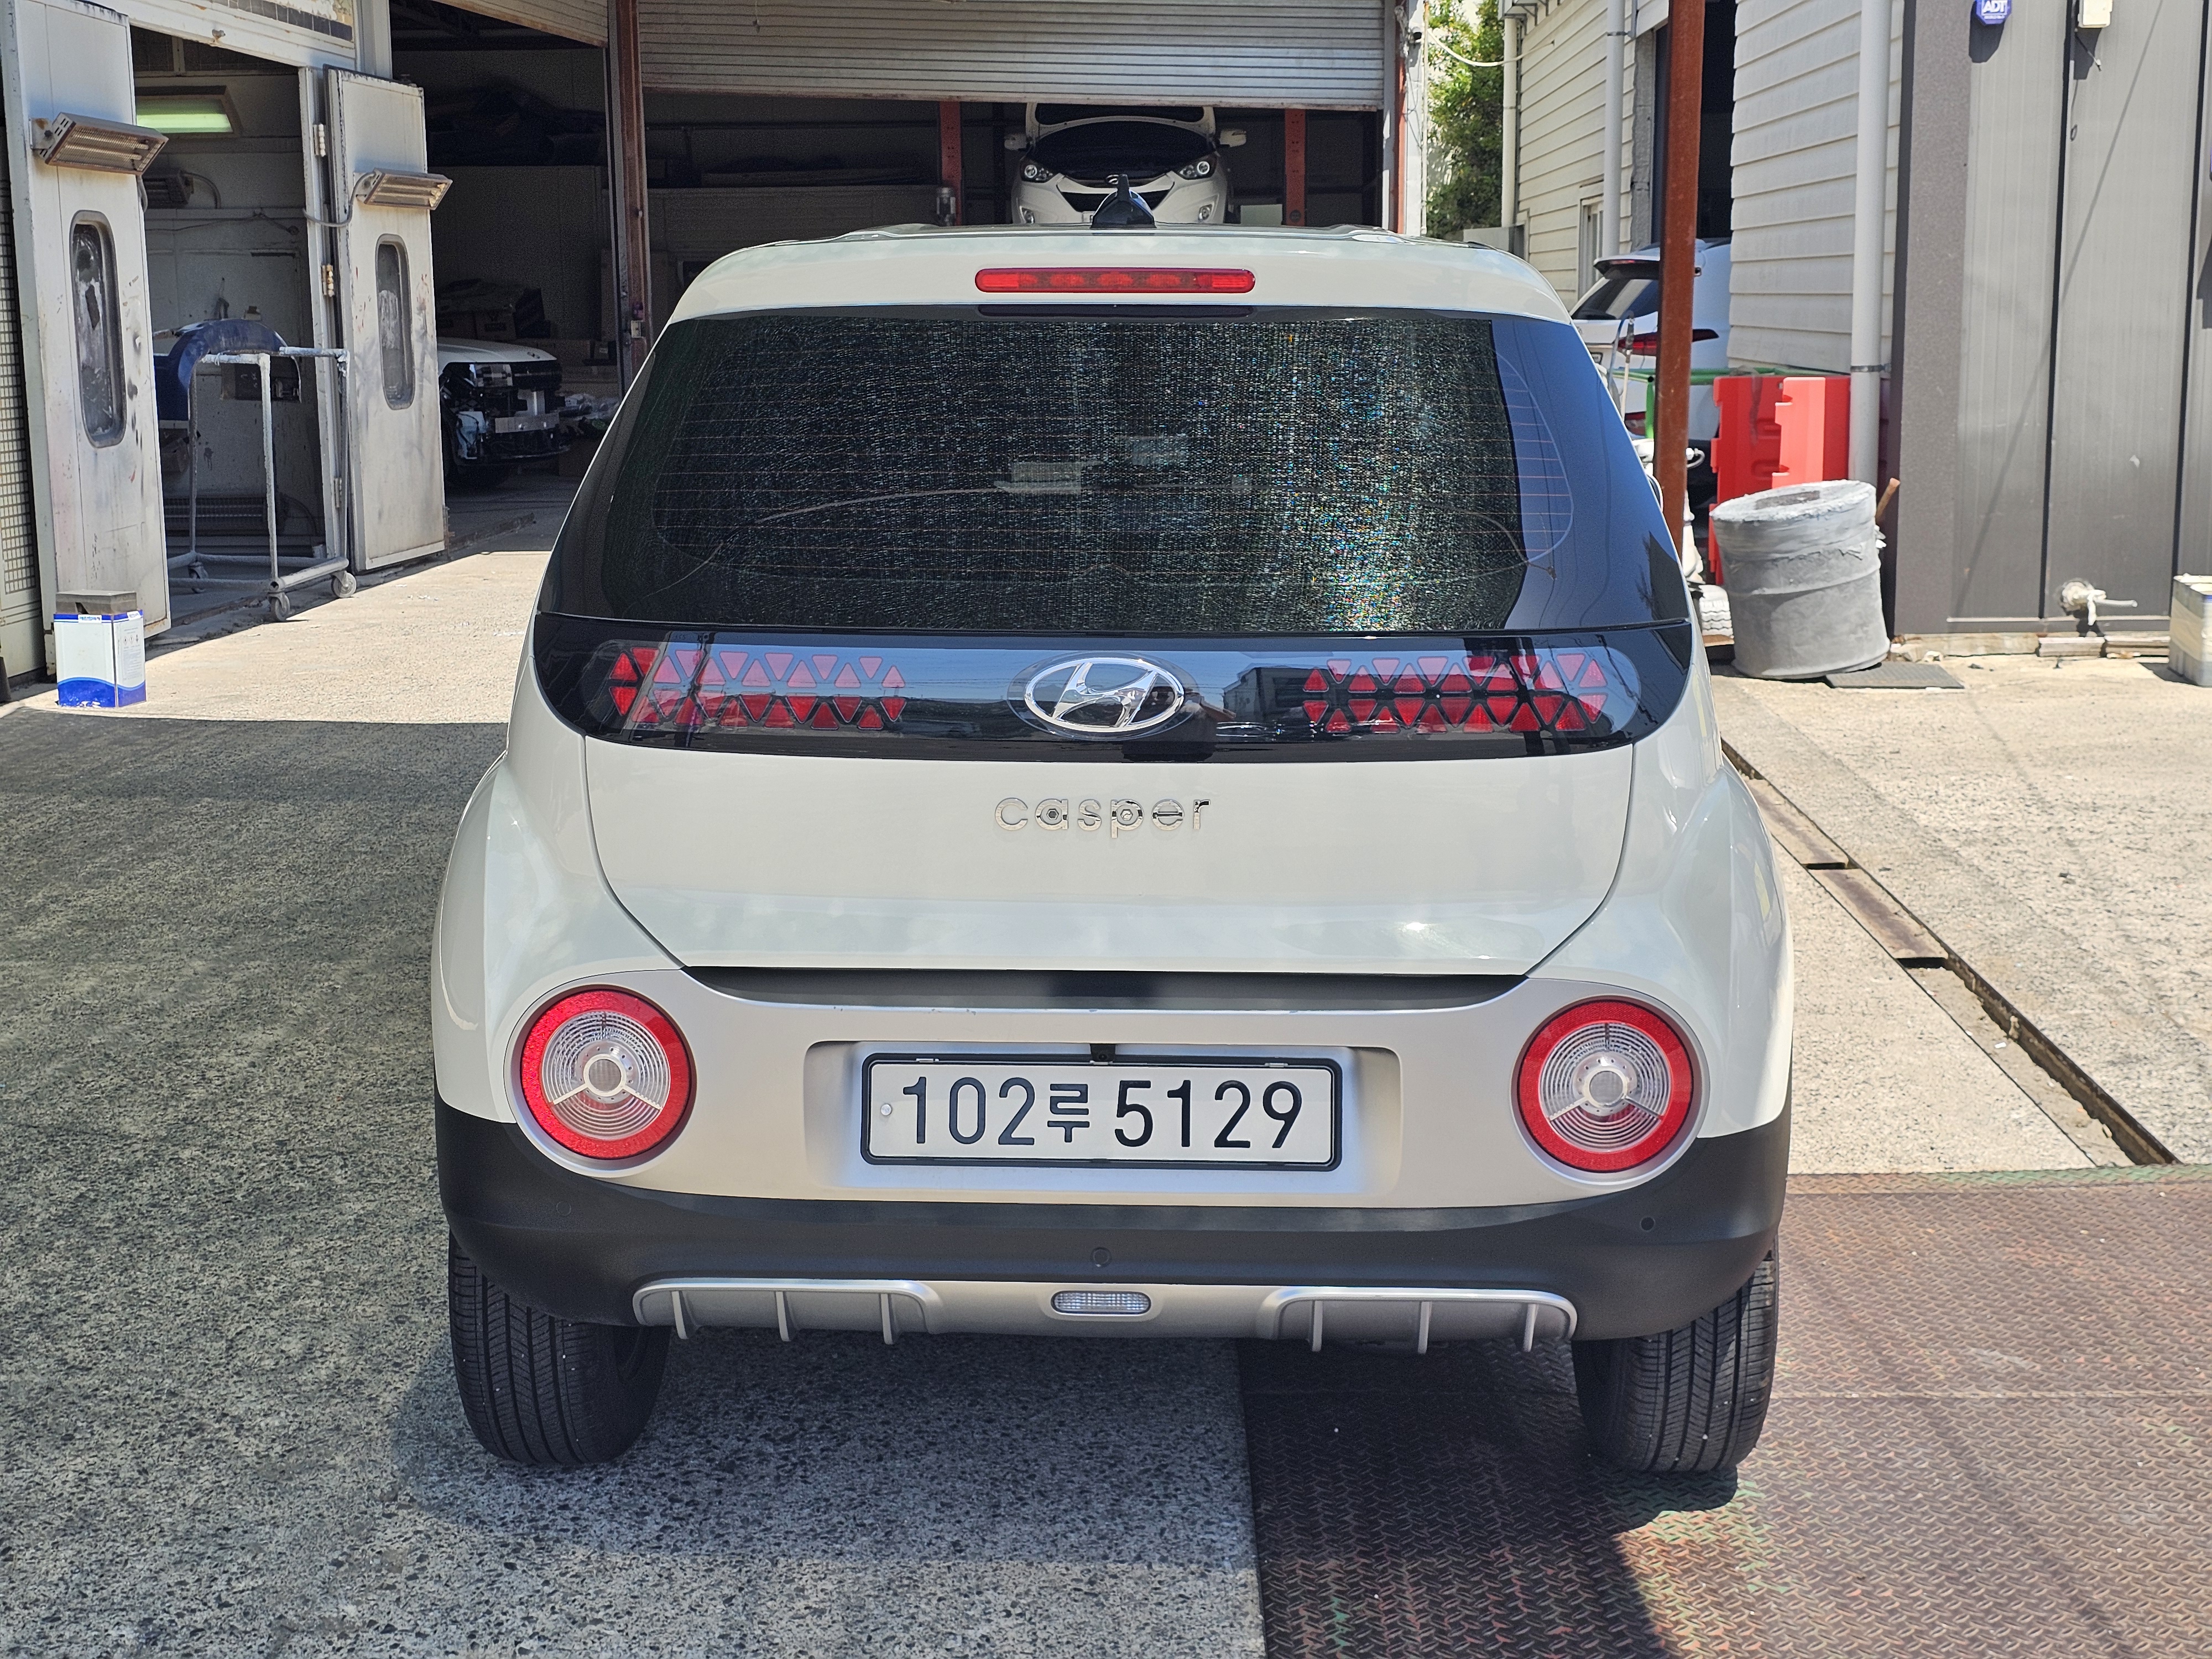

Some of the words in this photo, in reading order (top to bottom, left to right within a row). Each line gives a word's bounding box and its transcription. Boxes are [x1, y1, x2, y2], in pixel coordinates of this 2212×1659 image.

[1983, 1, 2007, 13] ADT
[994, 797, 1211, 839] casper
[902, 1076, 1091, 1146] 102루
[1114, 1079, 1302, 1149] 5129
